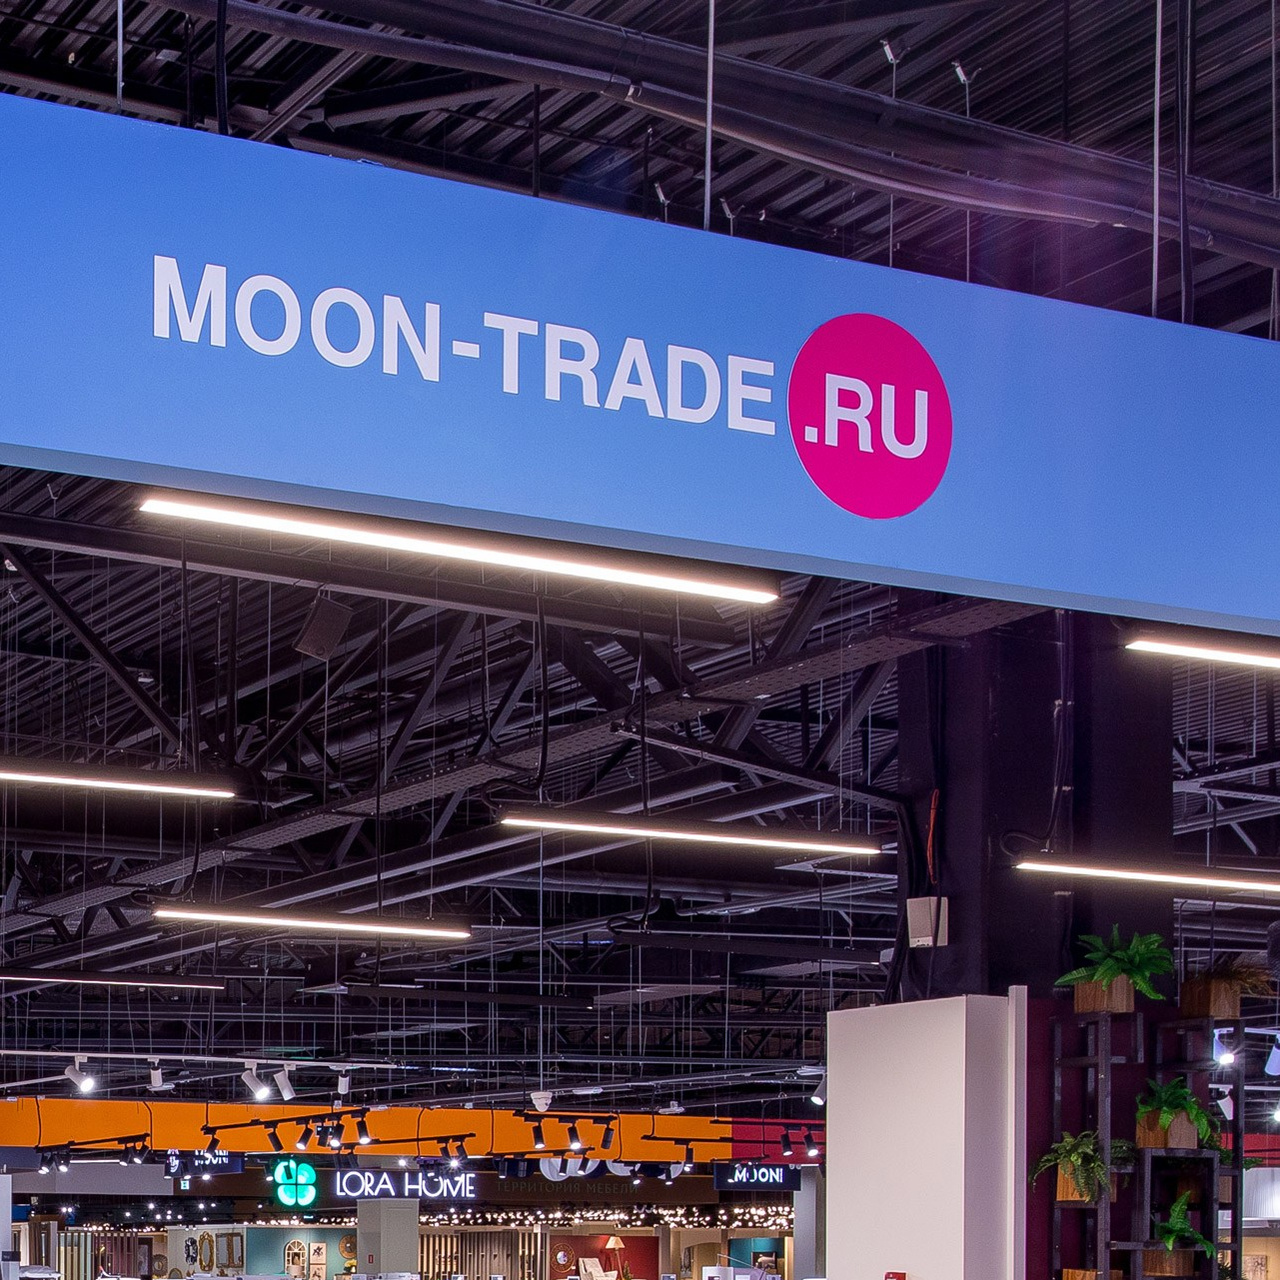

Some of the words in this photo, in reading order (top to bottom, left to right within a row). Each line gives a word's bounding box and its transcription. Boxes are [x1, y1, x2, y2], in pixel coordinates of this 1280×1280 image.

[152, 254, 776, 436] MOON-TRADE
[336, 1171, 395, 1197] LORA
[405, 1171, 475, 1198] HOME
[496, 1182, 581, 1193] ТЕРРИТОРИЯ
[586, 1182, 639, 1194] МЕБЕЛИ
